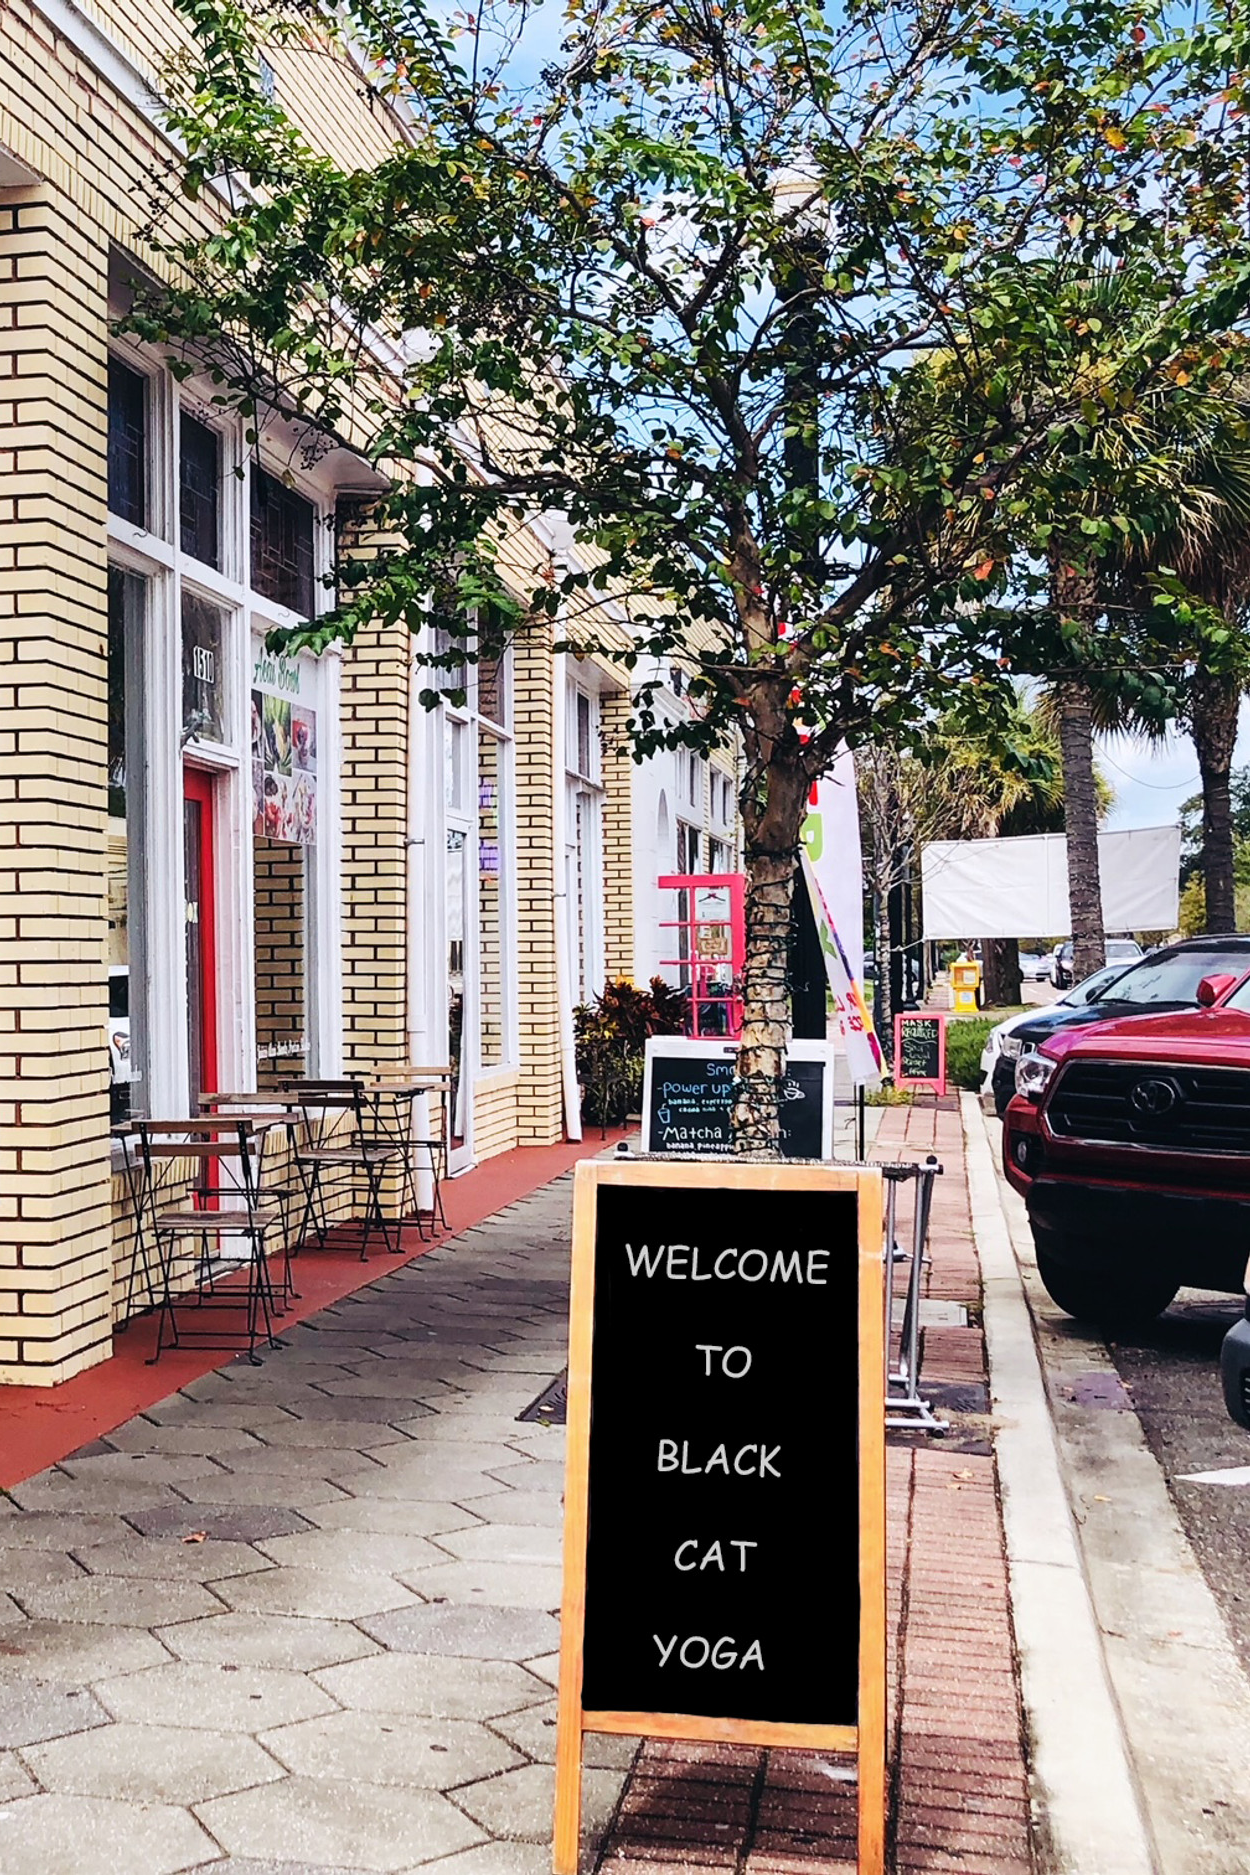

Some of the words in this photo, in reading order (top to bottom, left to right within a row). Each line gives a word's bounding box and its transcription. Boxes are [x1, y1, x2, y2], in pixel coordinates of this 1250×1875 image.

[901, 1019, 932, 1027] MASK
[901, 1027, 938, 1040] REQUIRED
[625, 1243, 831, 1285] WELCOME
[695, 1344, 752, 1378] TO
[657, 1439, 781, 1478] BLACK
[674, 1540, 757, 1571] CAT
[653, 1634, 764, 1671] YOGA
